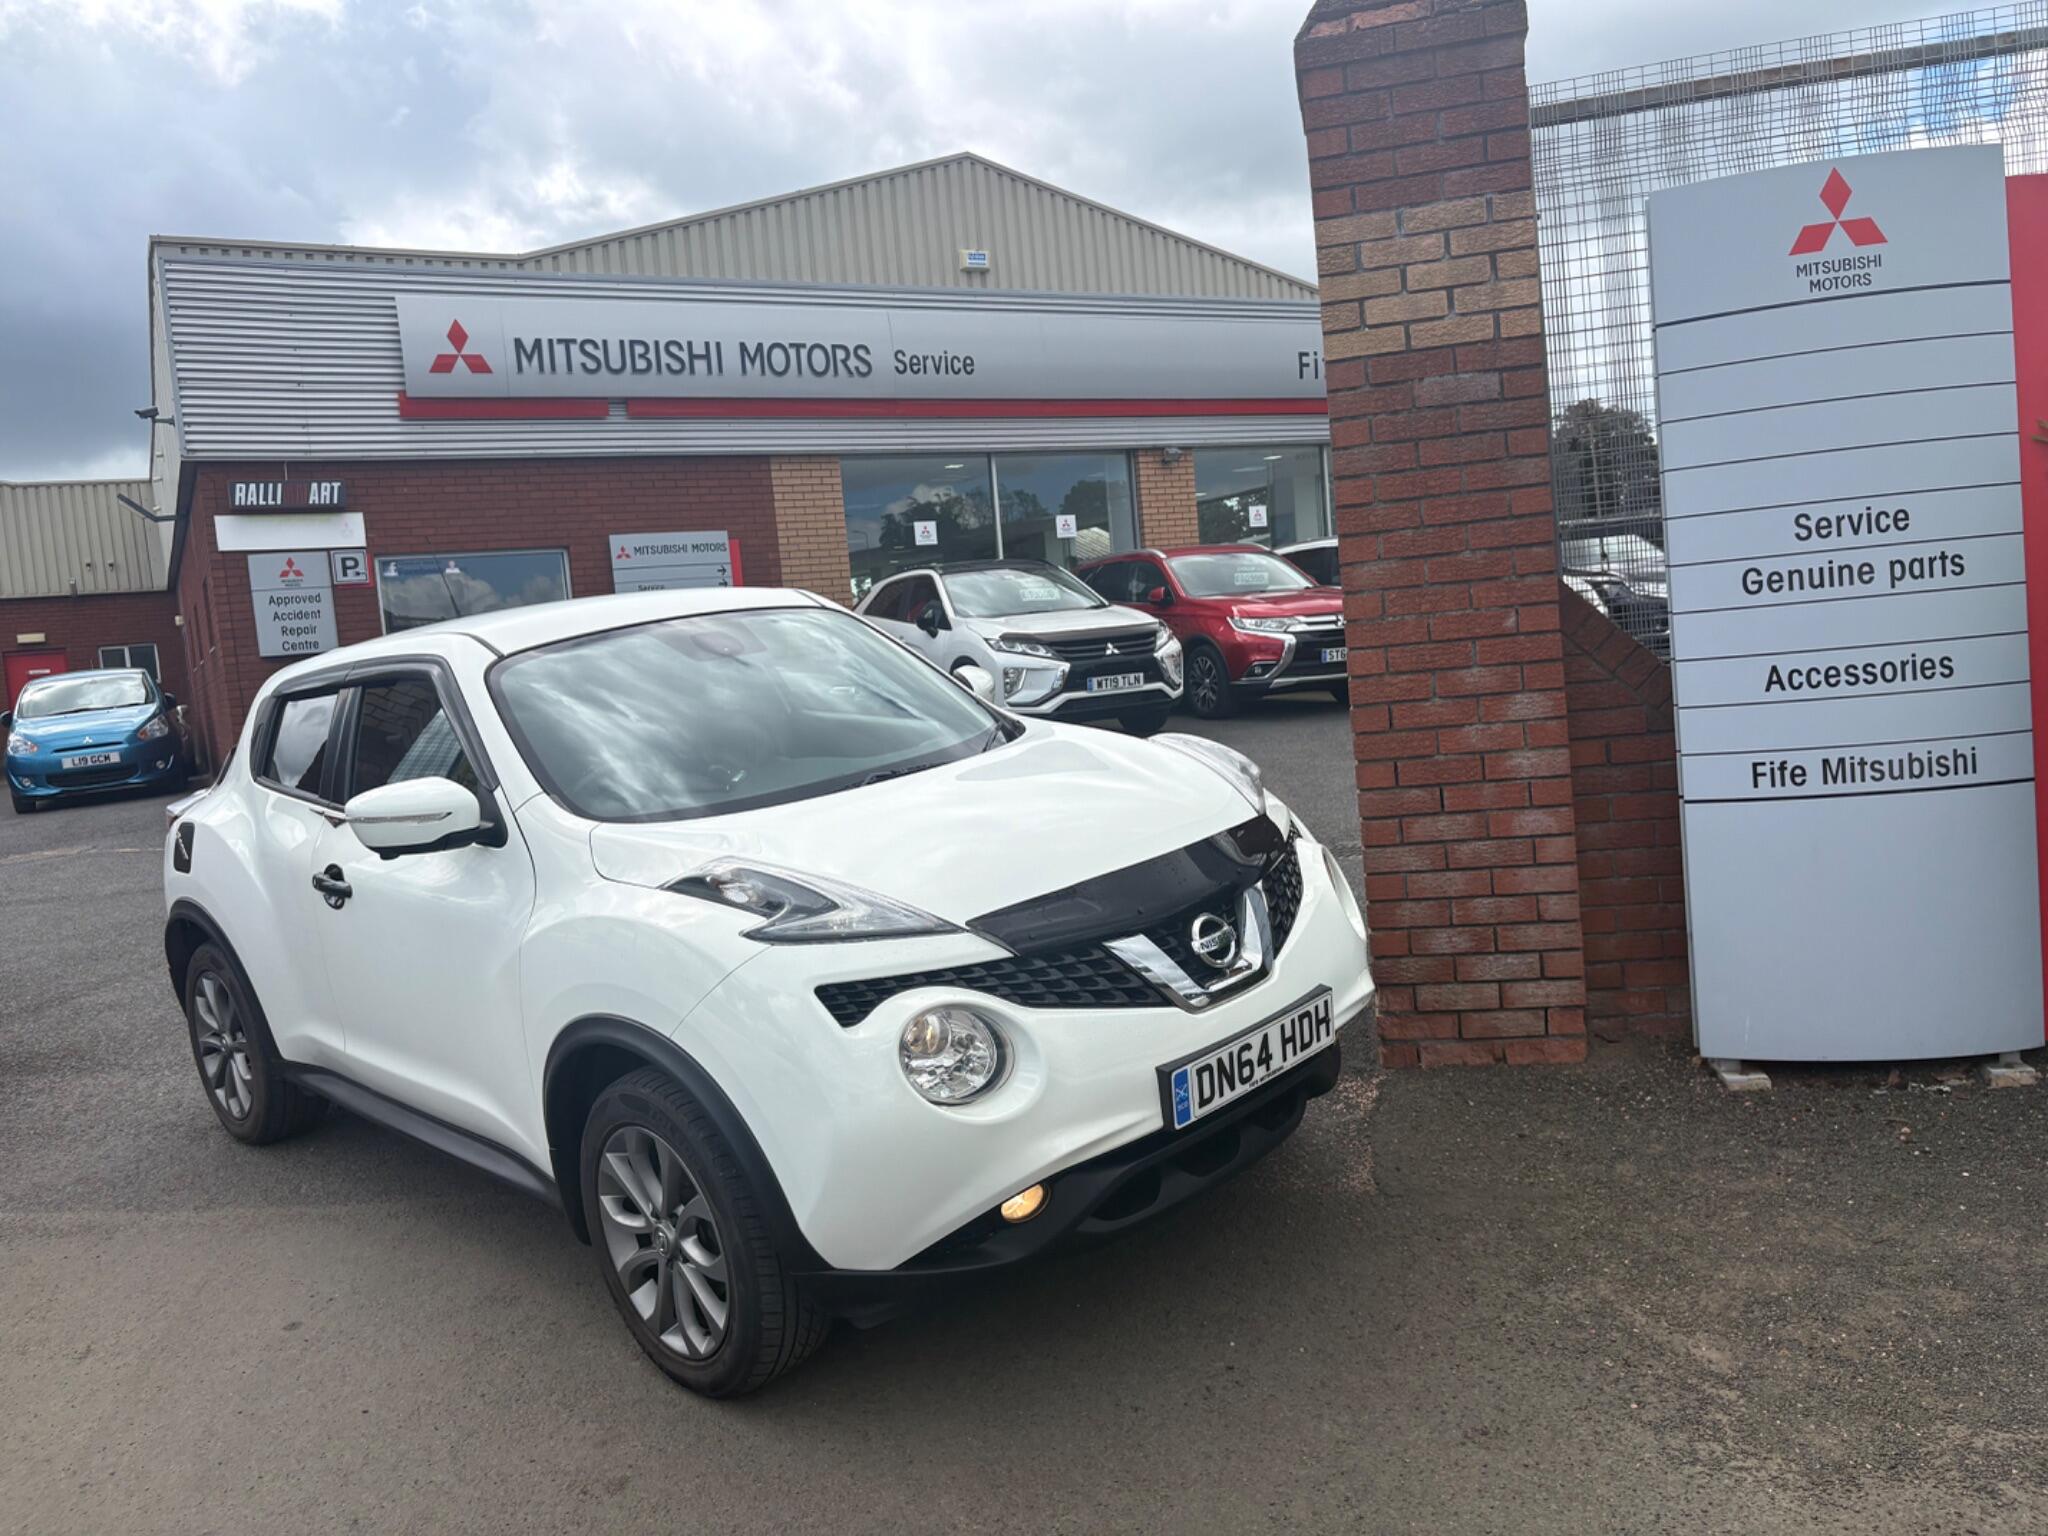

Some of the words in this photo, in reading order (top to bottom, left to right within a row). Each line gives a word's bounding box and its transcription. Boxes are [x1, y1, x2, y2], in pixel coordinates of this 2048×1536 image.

[1796, 253, 1882, 278] MITSUBISHI
[1809, 272, 1873, 293] MOTORS
[513, 337, 725, 375] MITSUBISHI
[738, 341, 873, 379] MOTORS
[893, 349, 975, 376] Service
[1298, 350, 1325, 380] Fi
[234, 483, 282, 506] RALLI
[308, 482, 341, 504] ART
[1794, 506, 1910, 541] Service
[633, 544, 687, 556] MITSUBISHI
[691, 542, 727, 552] MOTORS
[340, 556, 359, 578] P
[1742, 560, 1875, 595] Genuine
[1889, 551, 1965, 589] parts
[268, 592, 322, 606] Approved
[273, 608, 321, 622] Accident
[281, 624, 317, 637] Repair
[282, 639, 320, 651] Centre
[1764, 653, 1955, 693] Accessories
[1751, 760, 1808, 789] Fife
[1821, 746, 1977, 785] Mitsubishi
[1196, 1032, 1273, 1109] DN64
[1280, 1000, 1331, 1063] HDH
